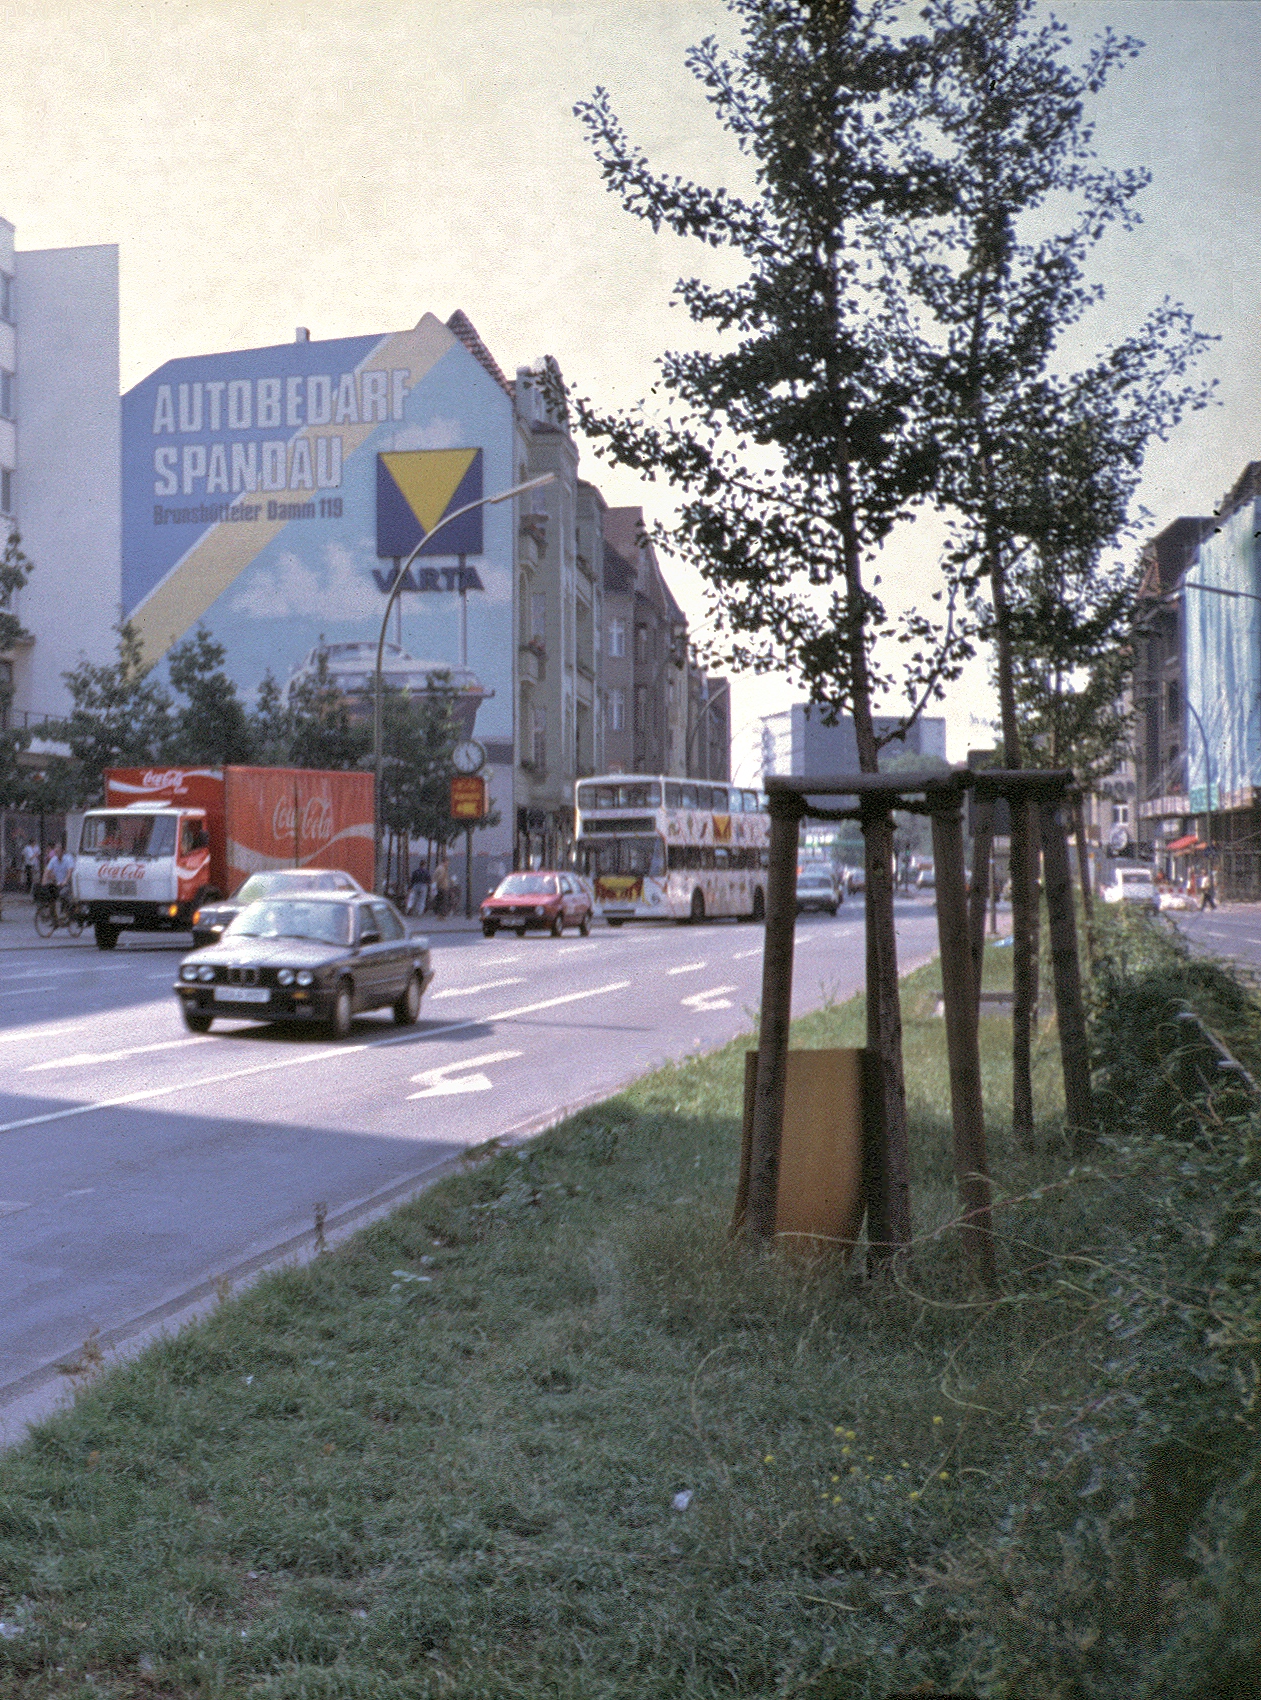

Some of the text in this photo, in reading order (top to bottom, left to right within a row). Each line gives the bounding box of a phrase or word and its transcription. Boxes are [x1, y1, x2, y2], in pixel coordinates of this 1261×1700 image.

[151, 367, 412, 435] AUTOBEDARF
[153, 434, 343, 497] SPANDAU
[266, 499, 316, 521] Damm
[318, 496, 344, 519] 119
[371, 565, 485, 595] VARTA
